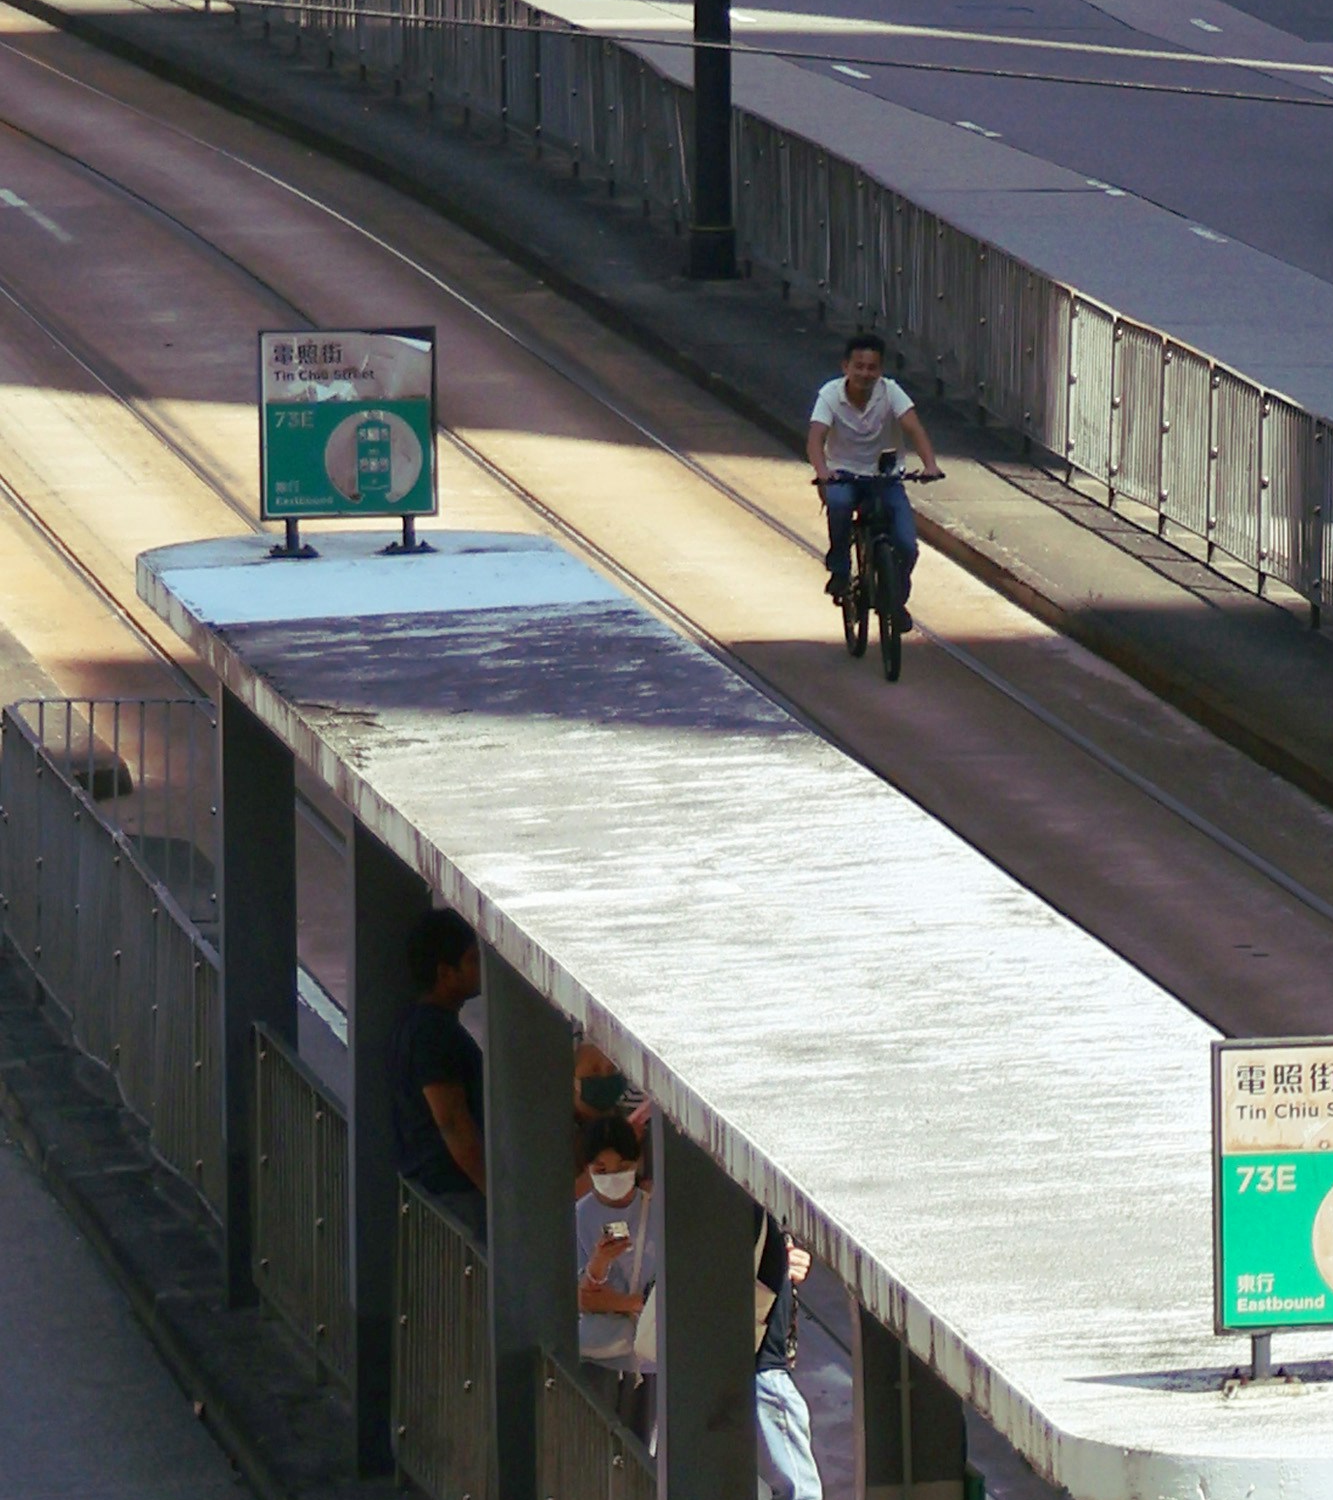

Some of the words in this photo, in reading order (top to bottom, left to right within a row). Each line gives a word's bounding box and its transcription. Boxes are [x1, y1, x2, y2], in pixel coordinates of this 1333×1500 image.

[273, 370, 295, 382] Tin
[1236, 1105, 1268, 1121] Tin
[1273, 1102, 1320, 1120] Chiu
[1236, 1165, 1297, 1193] 73E
[1236, 1273, 1275, 1293] 東行
[1236, 1294, 1326, 1313] Eastbound
